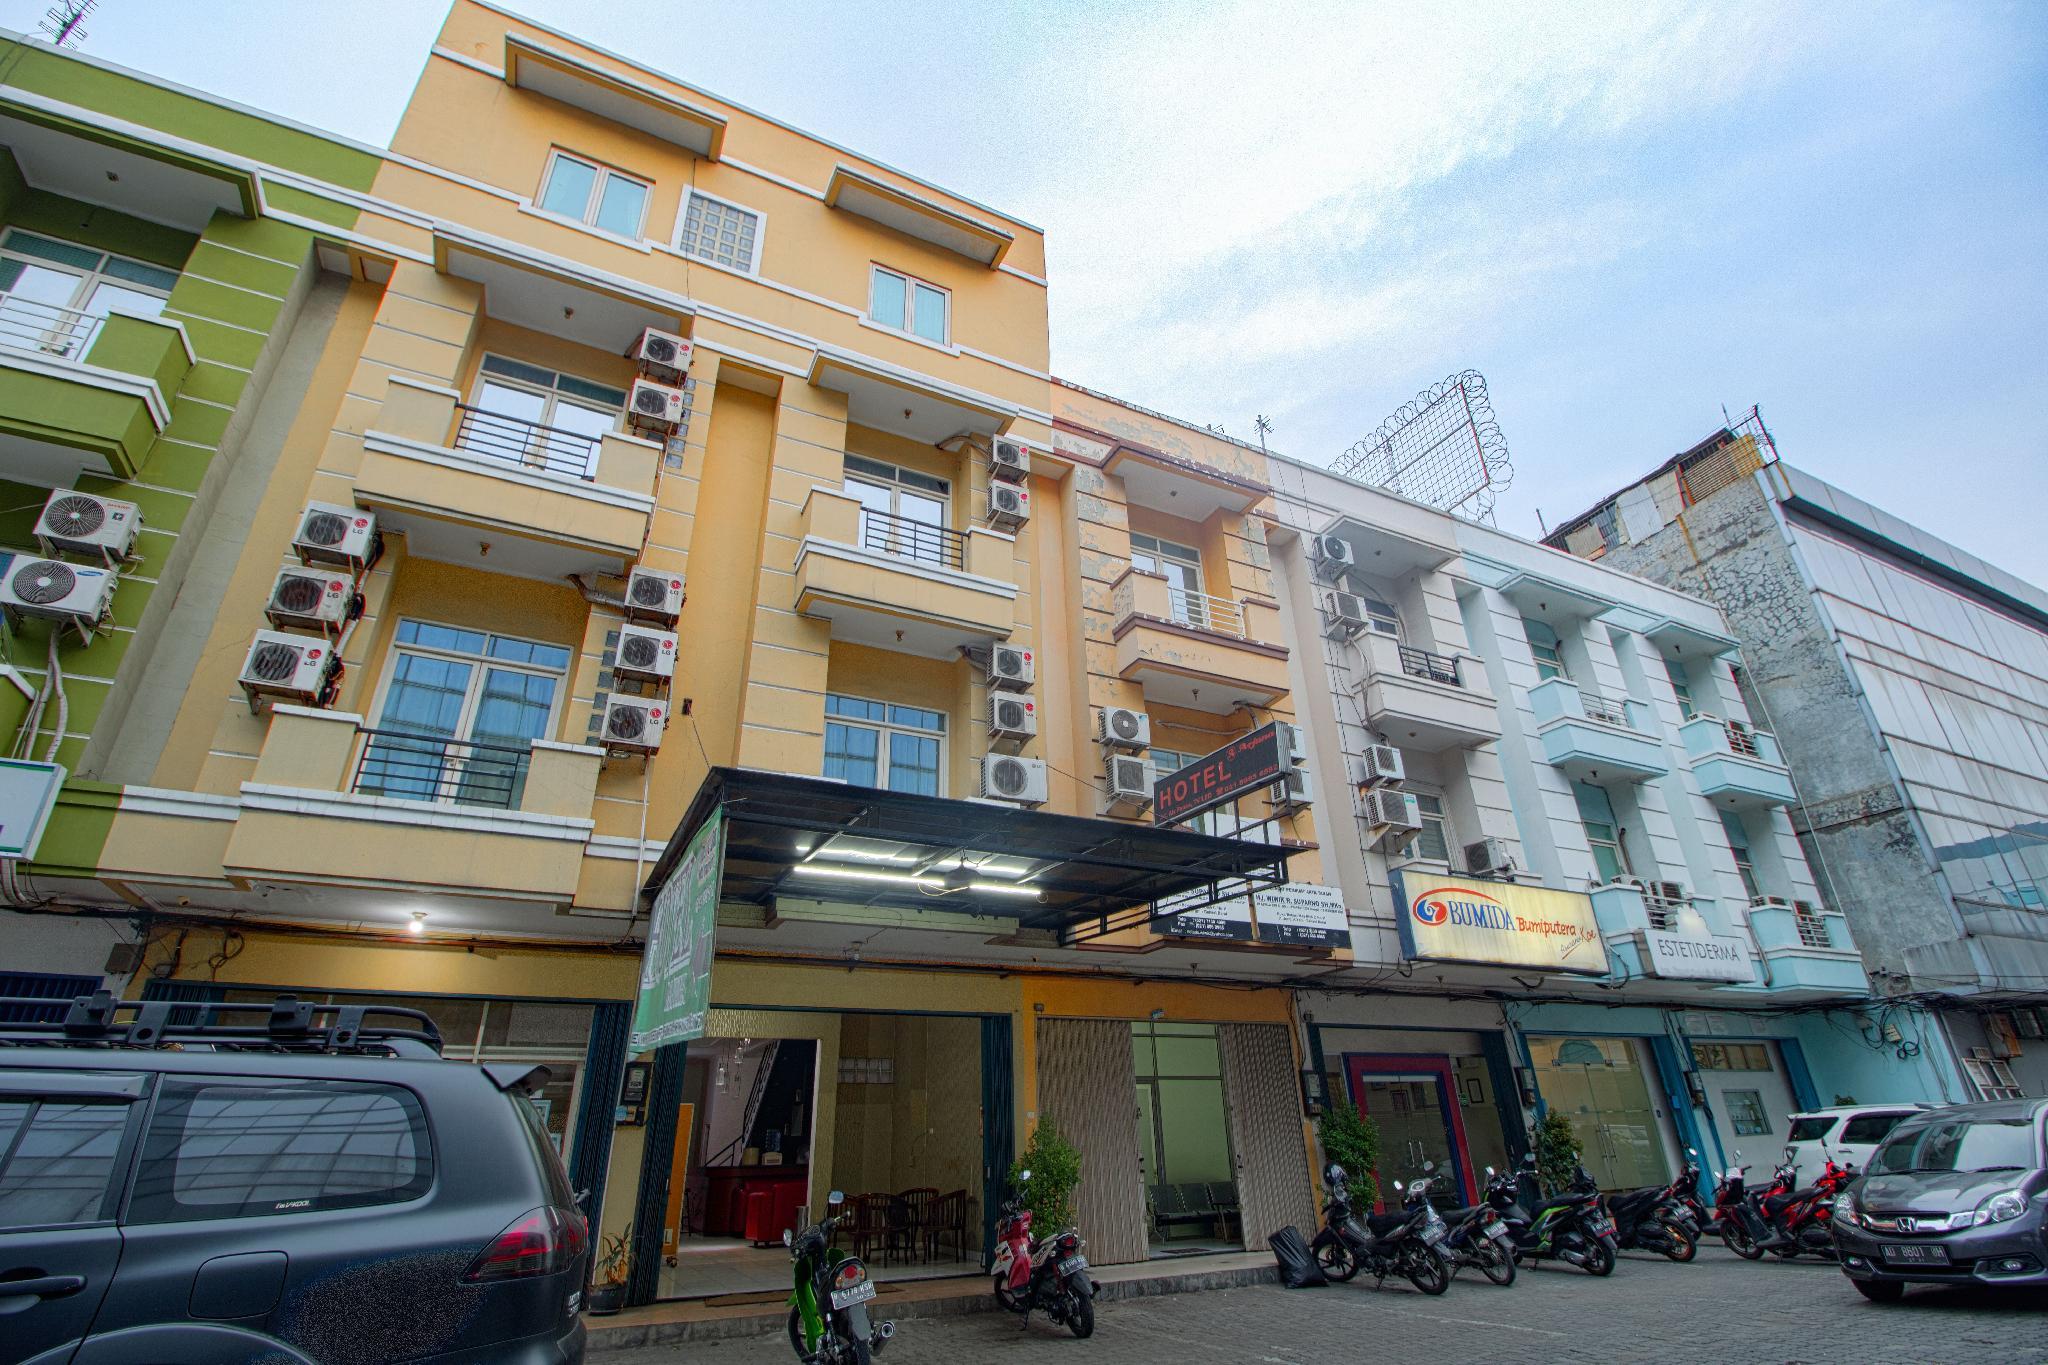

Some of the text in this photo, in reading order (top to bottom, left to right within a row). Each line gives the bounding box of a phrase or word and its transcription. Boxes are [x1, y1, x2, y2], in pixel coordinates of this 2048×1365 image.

[1160, 760, 1232, 810] HOTEL
[1448, 900, 1516, 931] BUMIDA
[1516, 916, 1577, 938] Bumiputera
[1658, 939, 1741, 961] ESTETIDERMA
